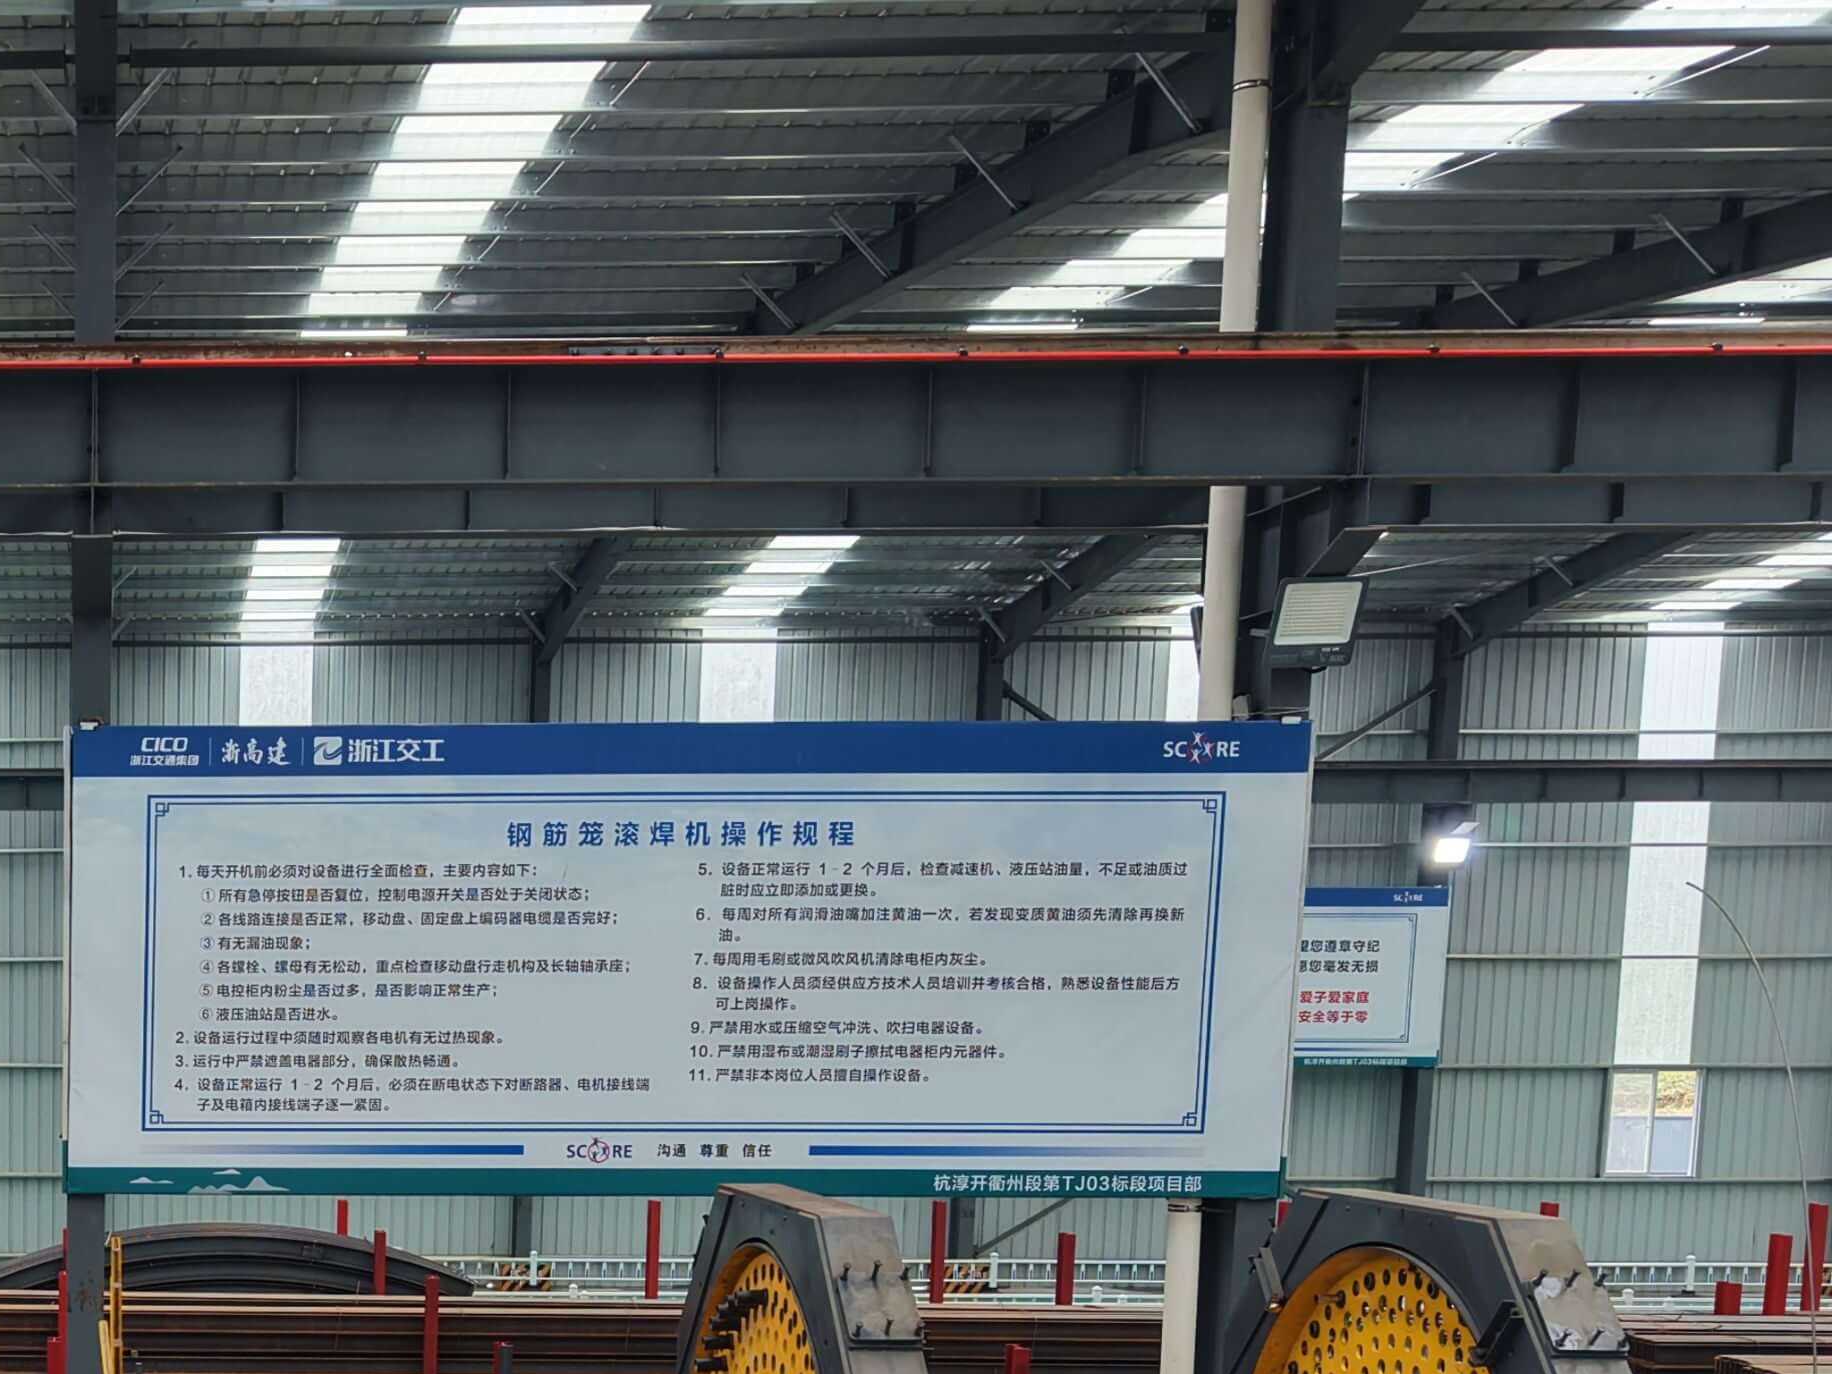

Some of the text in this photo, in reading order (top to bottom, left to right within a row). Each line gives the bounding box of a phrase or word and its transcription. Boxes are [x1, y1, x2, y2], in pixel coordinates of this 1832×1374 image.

[141, 737, 188, 752] CICO
[348, 739, 445, 762] 浙江交工
[130, 755, 200, 767] 浙江交通集团
[507, 821, 855, 848] 钢筋笼滚焊机操作规程
[657, 1143, 772, 1158] 沟通 尊重 信任
[933, 1174, 1202, 1193] 杭淳开衢州段第TJ03标段项目部
